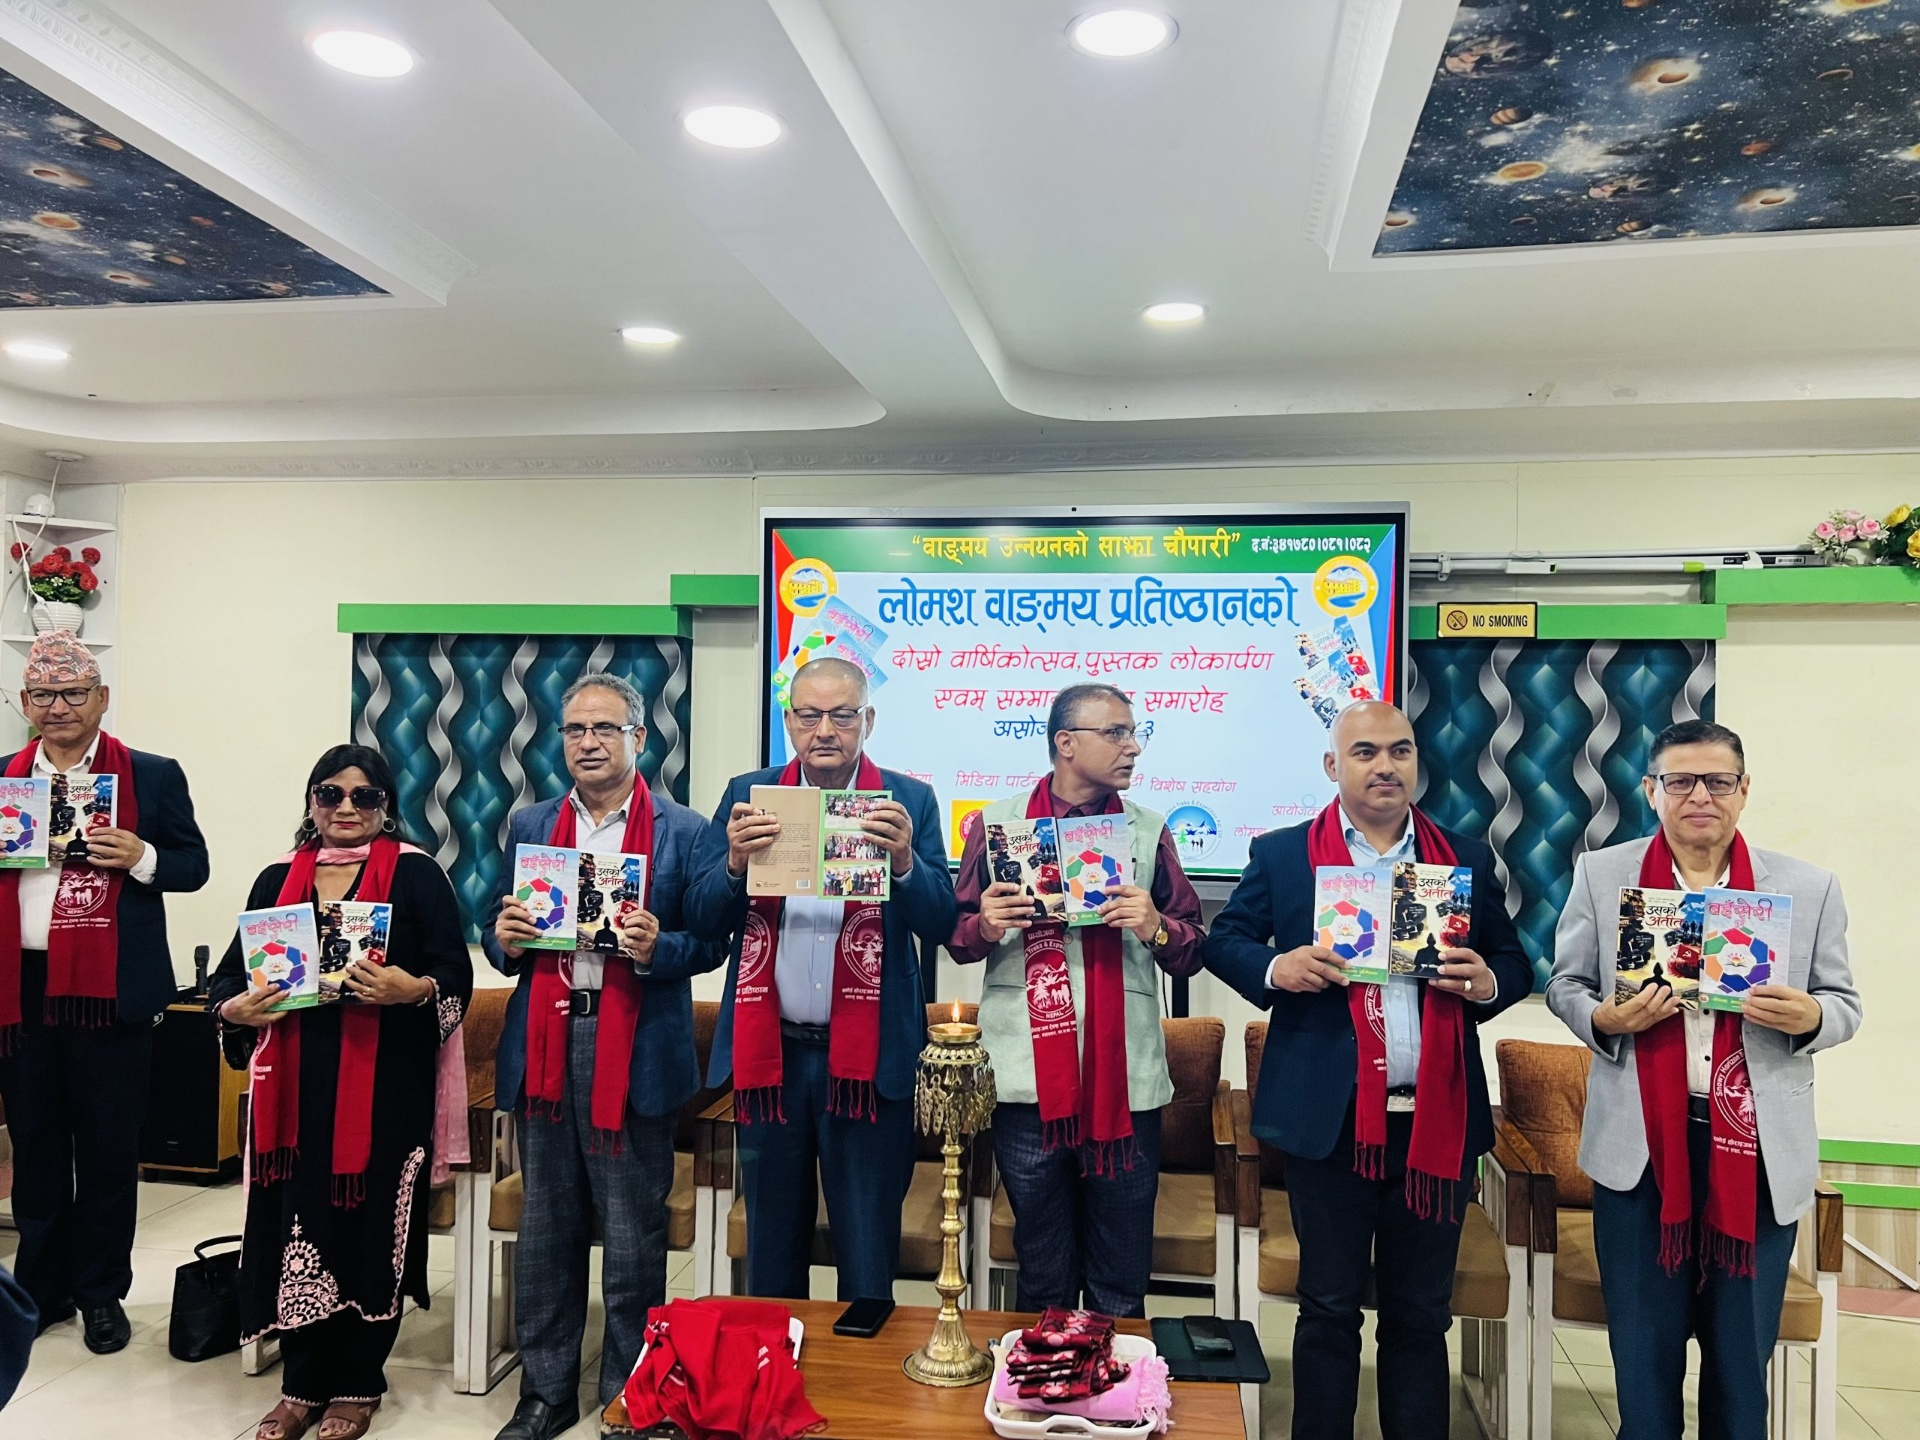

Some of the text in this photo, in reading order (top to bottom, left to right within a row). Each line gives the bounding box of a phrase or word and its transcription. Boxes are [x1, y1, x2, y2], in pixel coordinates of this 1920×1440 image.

[878, 576, 1300, 633] लोमश वाङ्मय प्रतिष्ठानको
[1472, 614, 1528, 627] NO SMOKING
[1170, 645, 1276, 673] लोकार्पण
[1144, 684, 1228, 713] समारोह
[956, 770, 1000, 788] मिडिया
[1150, 776, 1186, 792] विशेष
[1191, 778, 1237, 794] सहयोग
[1008, 832, 1033, 845] उसको
[1010, 842, 1040, 855] अतीत
[598, 876, 625, 887] अतीत
[1418, 875, 1448, 888] उसको
[1418, 888, 1452, 899] अतीत
[1646, 904, 1678, 916] उसको
[1646, 916, 1682, 928] अतीत
[344, 924, 372, 934] अतीत
[1046, 1010, 1064, 1018] NEPAL
[1716, 1055, 1741, 1097] Snowy Horizon
